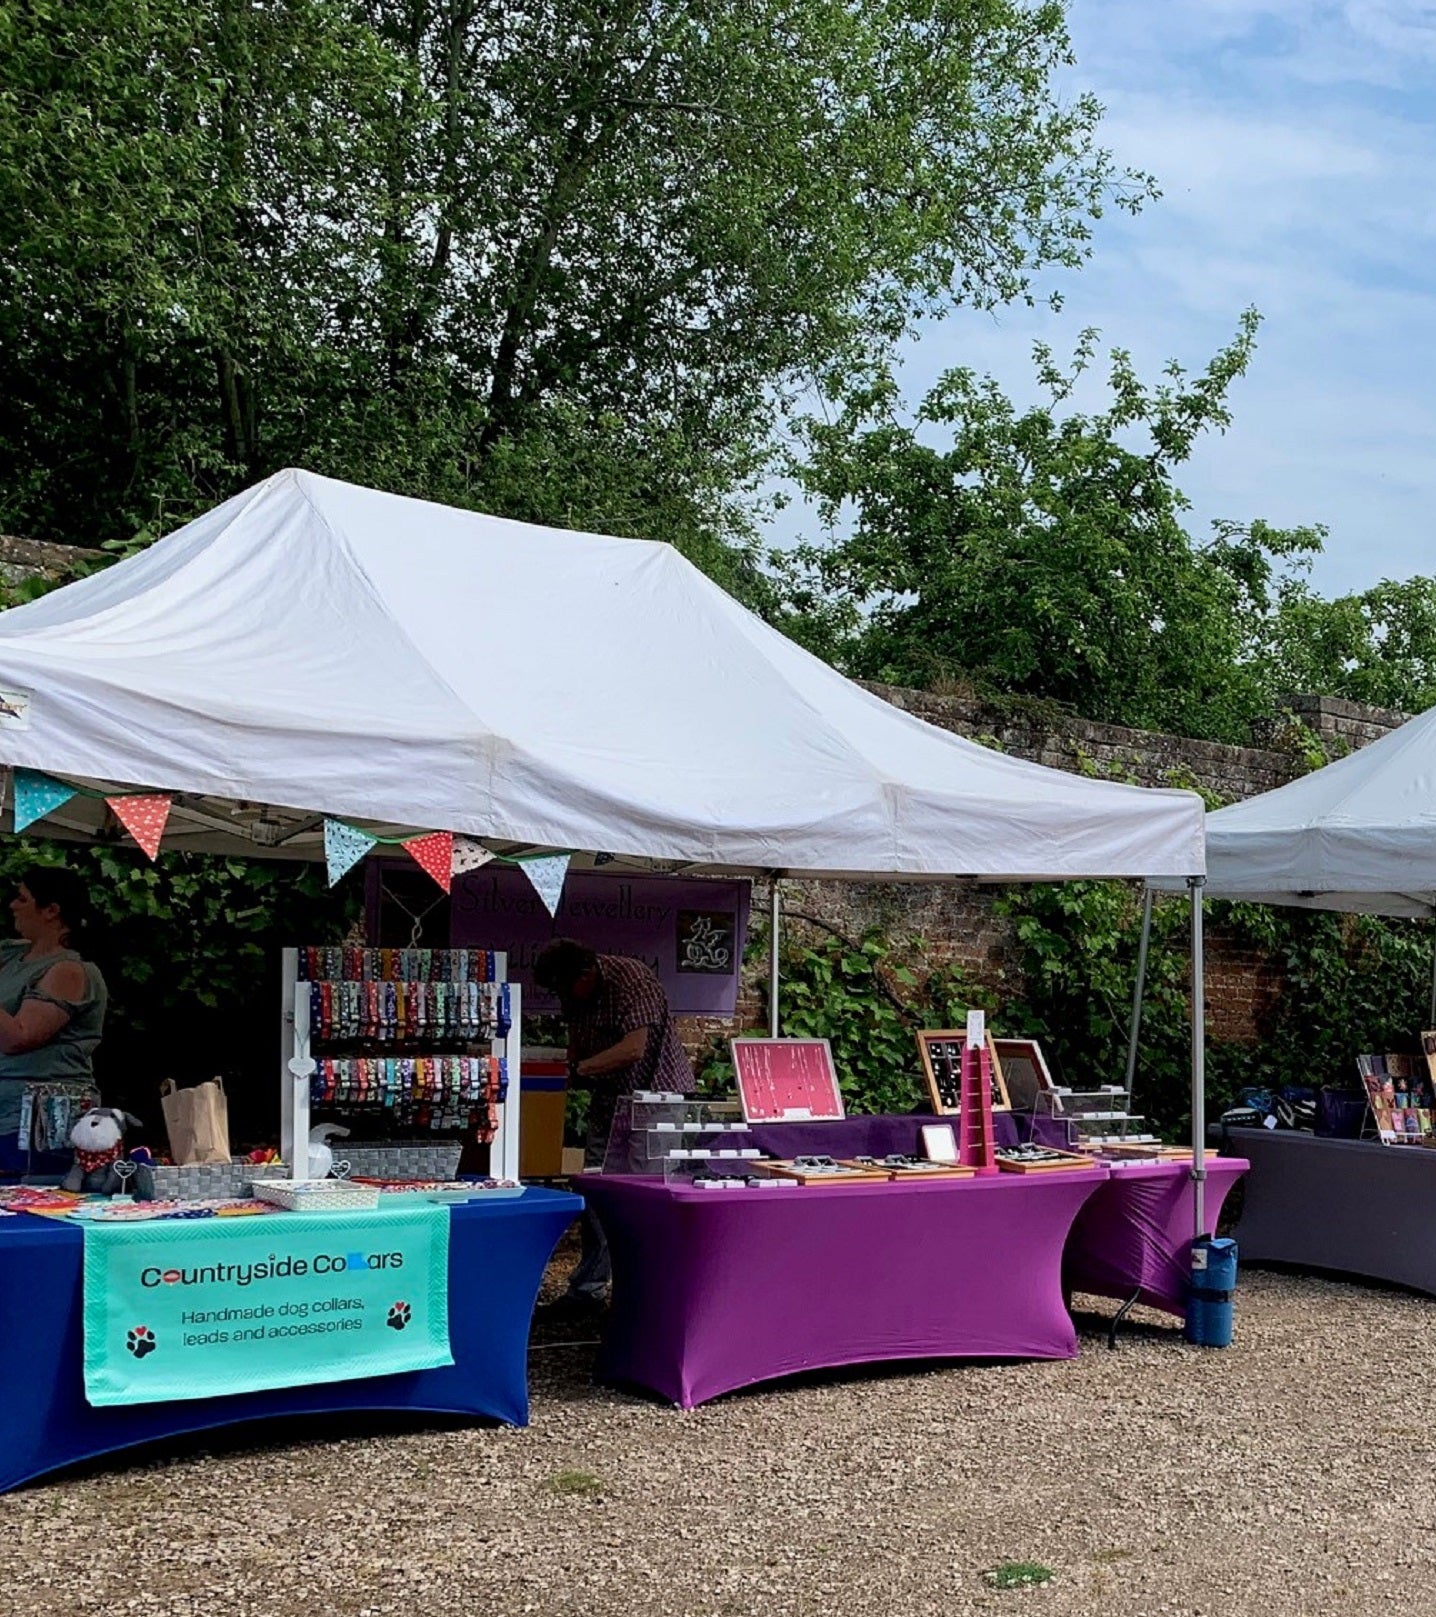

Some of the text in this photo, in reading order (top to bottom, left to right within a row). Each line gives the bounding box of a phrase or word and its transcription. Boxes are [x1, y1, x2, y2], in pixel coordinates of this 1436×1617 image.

[312, 1250, 404, 1275] Coars
[181, 1296, 365, 1325] Handmade dog collars,
[183, 1317, 363, 1346] leads and accessories
